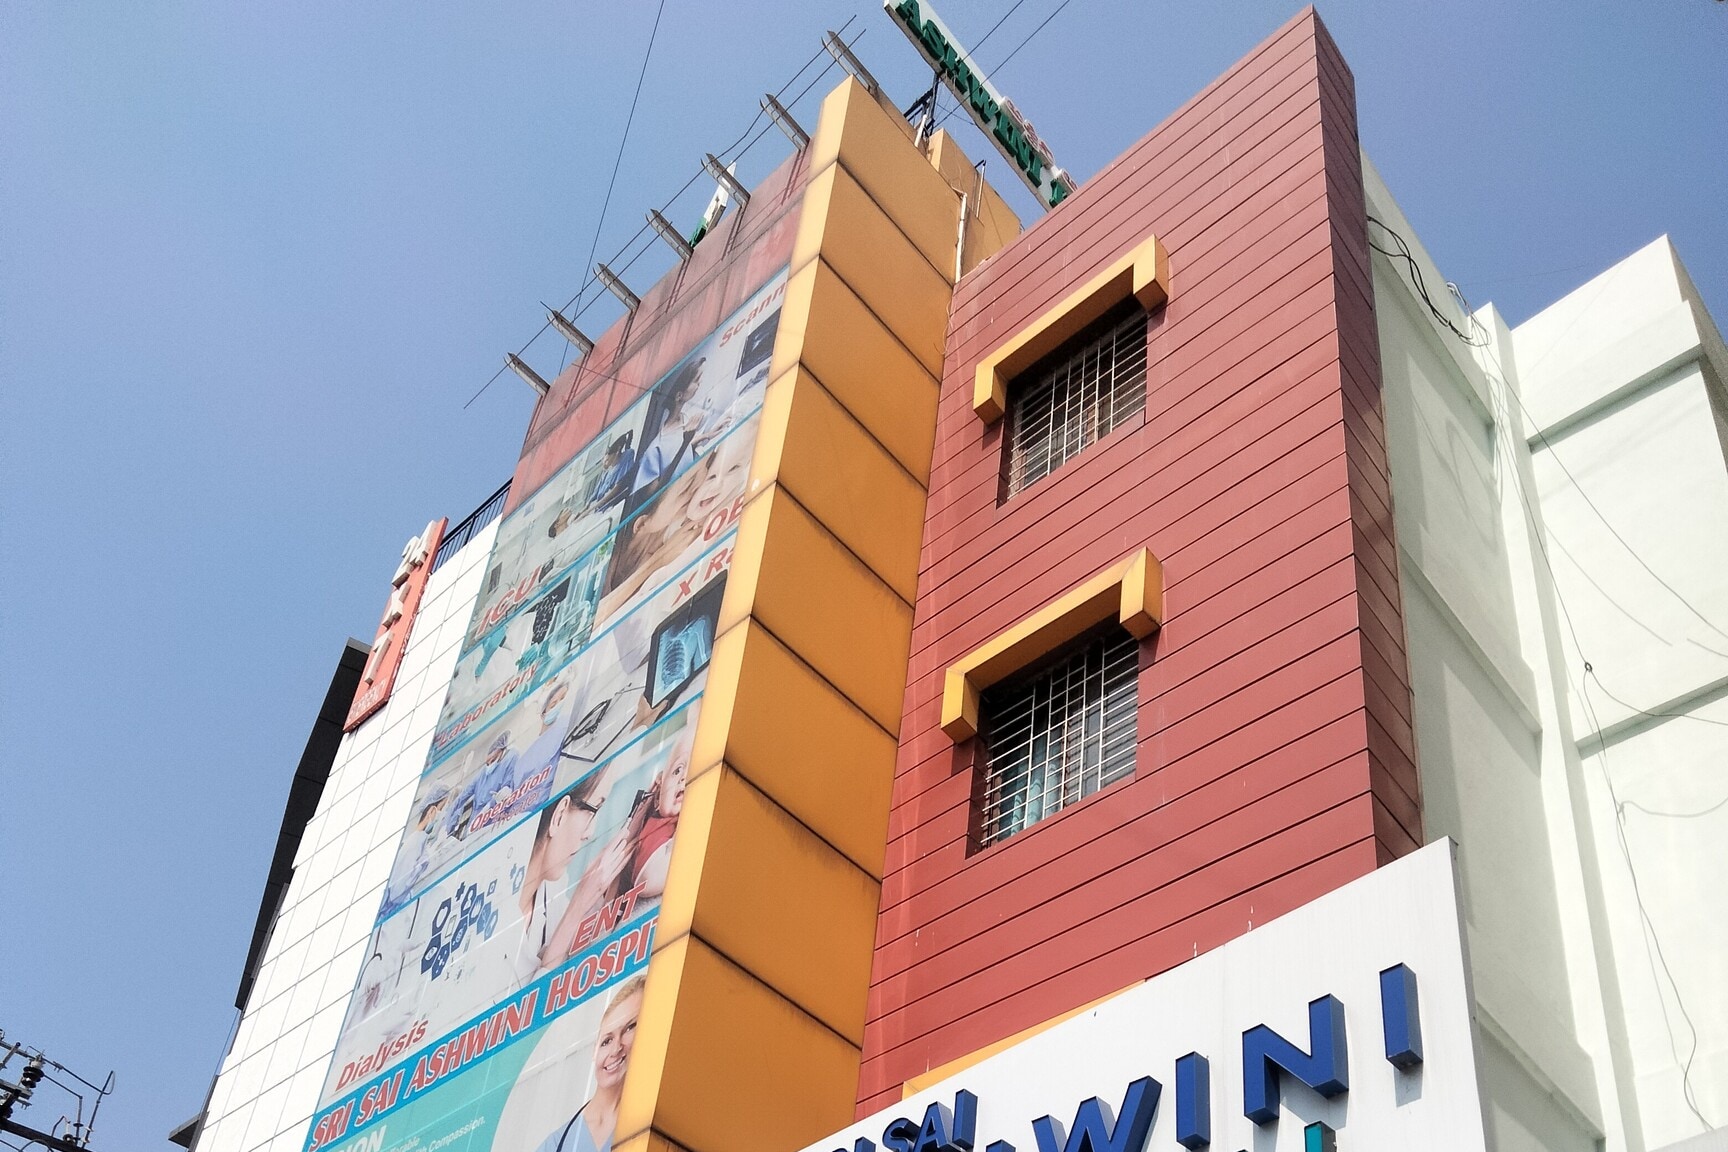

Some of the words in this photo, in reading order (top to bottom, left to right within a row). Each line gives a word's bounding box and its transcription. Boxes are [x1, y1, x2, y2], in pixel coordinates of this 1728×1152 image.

[475, 565, 542, 639] ICU
[436, 659, 540, 748] Laboratory
[470, 765, 552, 833] Operation
[569, 881, 647, 955] ENT
[335, 1019, 429, 1092] Dialysis
[354, 1069, 406, 1127] SAI
[404, 990, 540, 1099] ASHWINI
